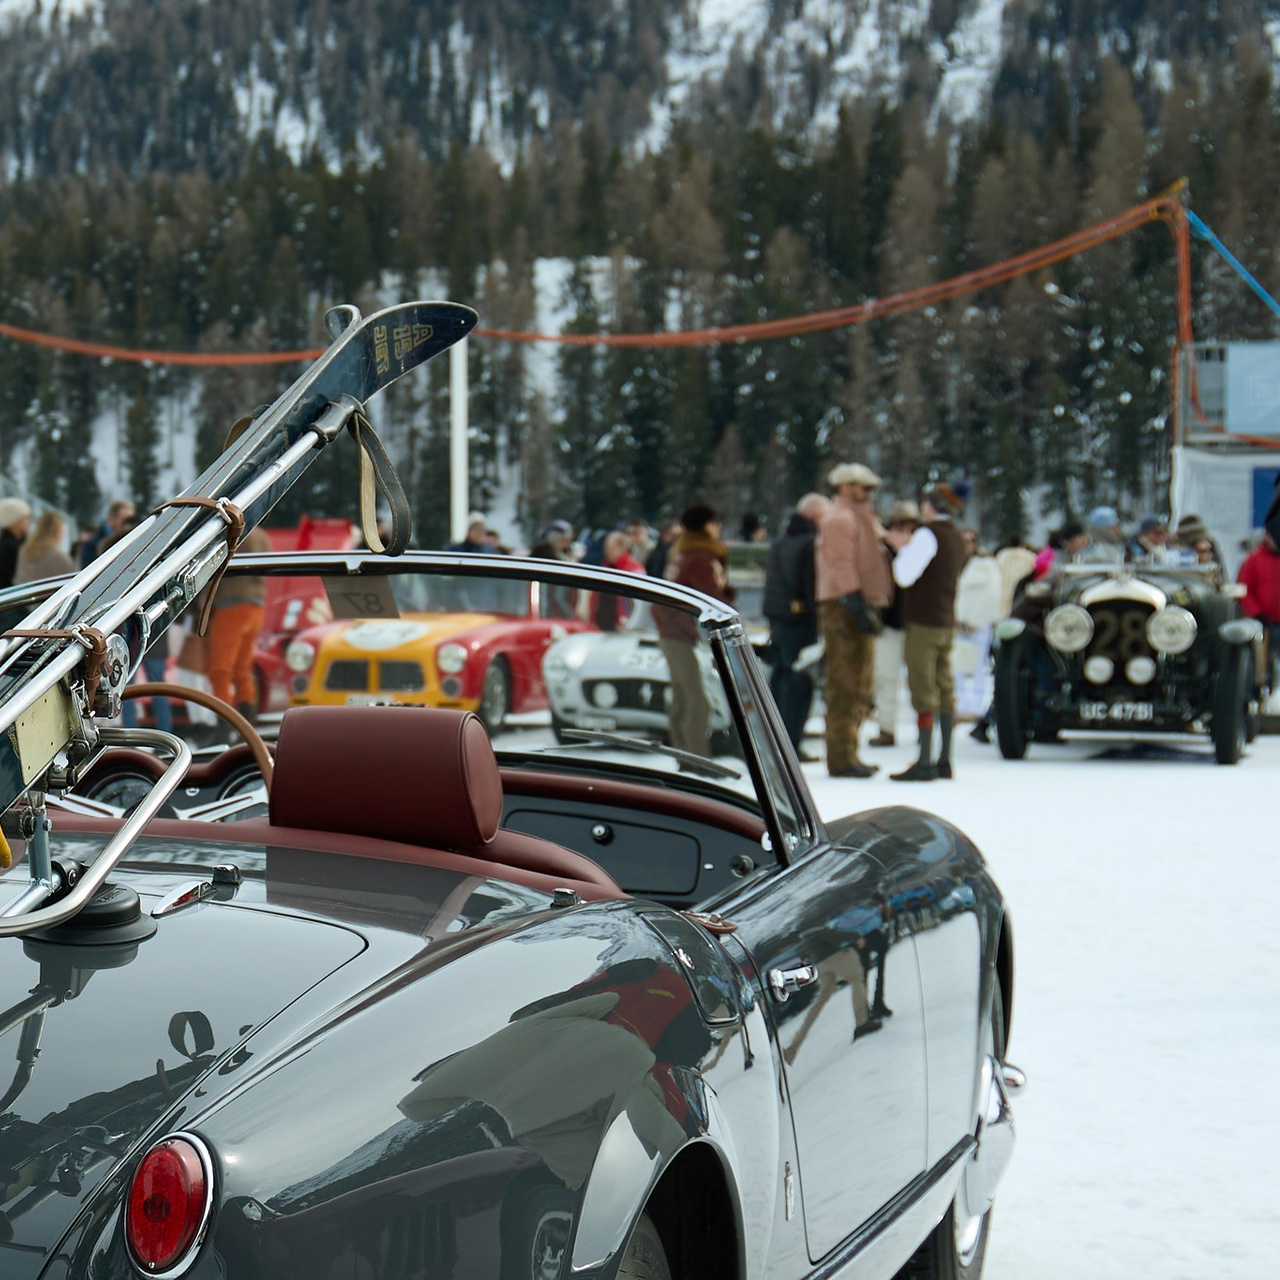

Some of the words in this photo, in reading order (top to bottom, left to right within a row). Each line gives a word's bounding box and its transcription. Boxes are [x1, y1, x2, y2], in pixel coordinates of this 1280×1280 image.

[373, 325, 390, 376] JET
[393, 325, 413, 360] 15
[412, 324, 434, 348] A
[1092, 609, 1148, 660] 28
